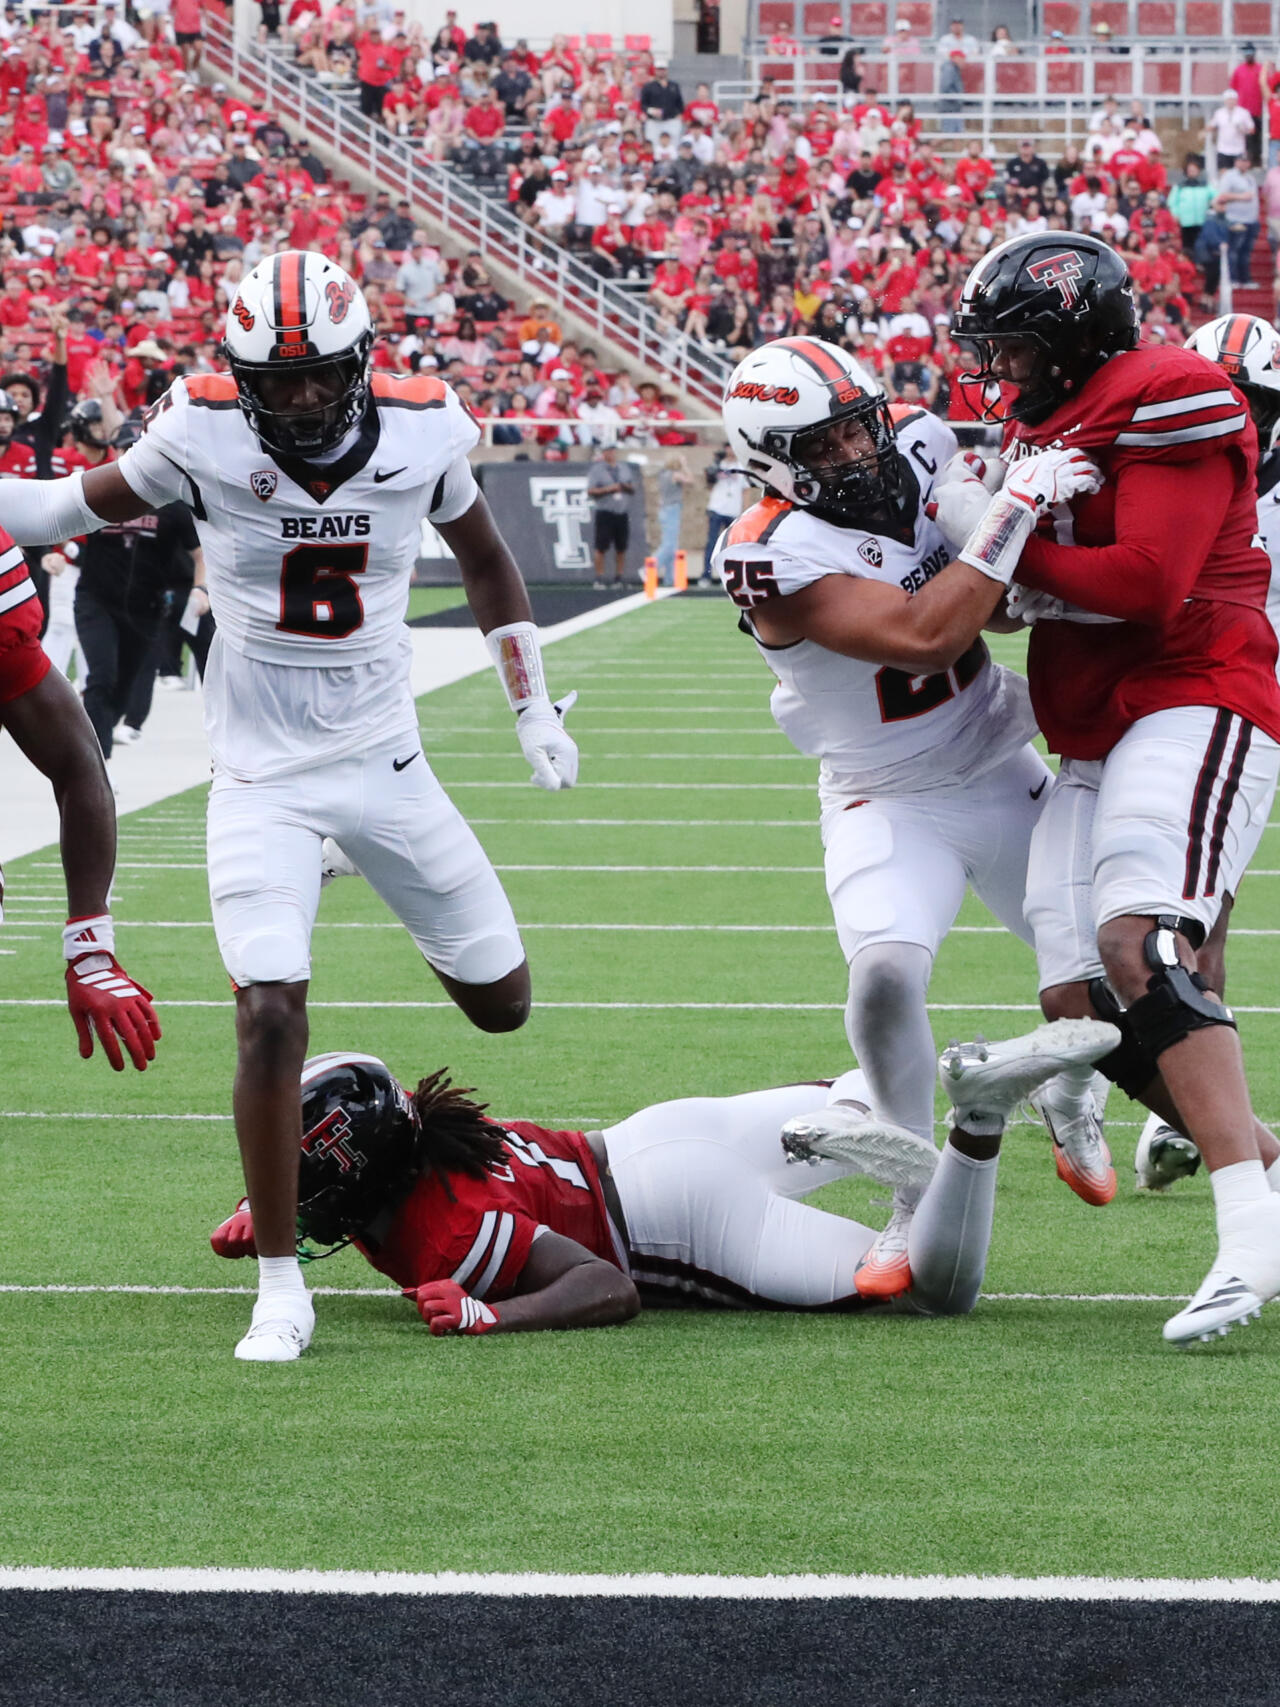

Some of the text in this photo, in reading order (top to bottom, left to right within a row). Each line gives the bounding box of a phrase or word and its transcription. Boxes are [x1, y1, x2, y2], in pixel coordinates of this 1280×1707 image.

[279, 343, 307, 358] OSU
[727, 378, 800, 406] eavers
[838, 386, 862, 405] OSU
[910, 440, 937, 475] C
[281, 514, 371, 539] BEAVS
[724, 559, 782, 608] 25
[900, 544, 950, 595] BEAVS
[275, 542, 369, 640] 6
